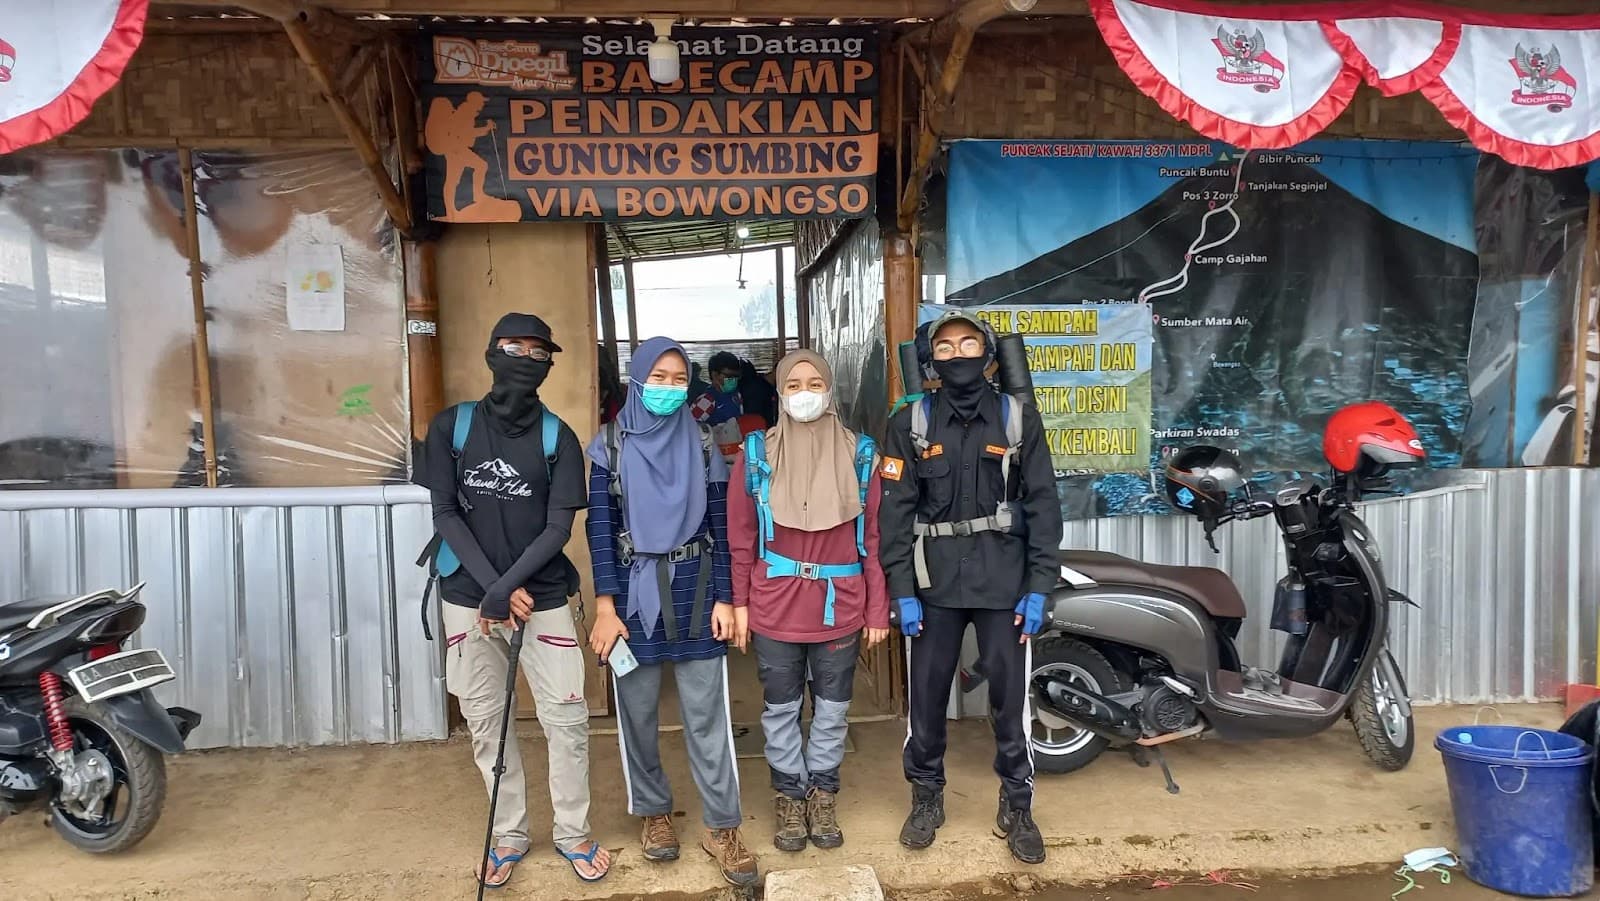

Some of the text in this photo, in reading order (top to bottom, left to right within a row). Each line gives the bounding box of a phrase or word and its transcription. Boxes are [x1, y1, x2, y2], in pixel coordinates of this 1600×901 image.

[736, 34, 864, 58] Datang
[1222, 75, 1275, 83] INDONESIA
[1516, 94, 1567, 104] INDONESIA
[509, 99, 872, 134] PENDAKIAN
[1001, 143, 1052, 158] PUNCAK
[1097, 144, 1143, 157] KAWAH
[1144, 143, 1175, 157] 3371
[1178, 143, 1213, 157] MDPL
[514, 141, 862, 176] GUNUNG SUMBING
[1259, 154, 1323, 164] Bibir Puncak
[1160, 167, 1230, 177] Puncak Buntu
[1248, 182, 1327, 192] Tanjakan Seginjel
[526, 183, 869, 217] VIA BOWONGSO
[1183, 191, 1239, 200] Pos 3 Zorro
[1195, 253, 1268, 266] Camp Gajahan
[1017, 310, 1098, 334] SAMPAH
[1161, 315, 1248, 327] Sumber Mata Air
[1026, 343, 1136, 372] SAMPAH DAN
[1075, 386, 1128, 413] DISINI
[1150, 426, 1240, 438] Parkiran Swadas
[1060, 428, 1137, 456] KEMBALI
[497, 479, 533, 497] Hike
